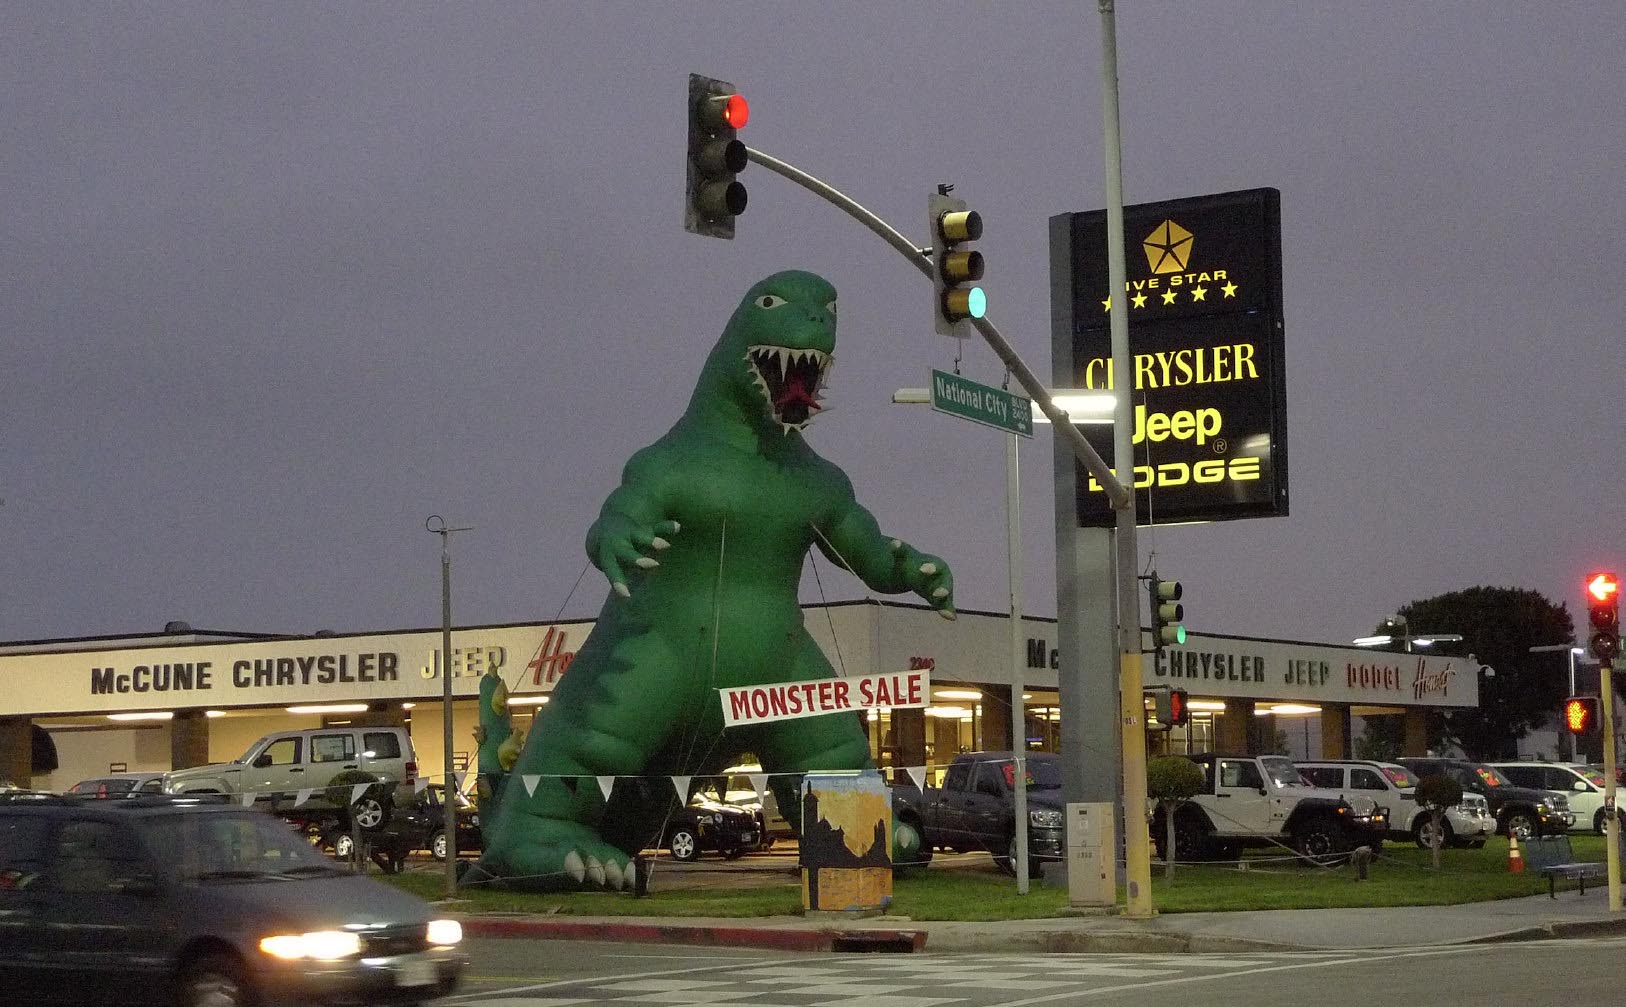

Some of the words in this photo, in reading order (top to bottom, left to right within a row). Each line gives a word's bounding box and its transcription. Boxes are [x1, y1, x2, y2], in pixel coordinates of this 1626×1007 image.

[1125, 277, 1160, 291] IVE
[1170, 269, 1228, 287] STAR
[936, 376, 982, 410] National
[985, 391, 1008, 423] City
[1131, 404, 1222, 446] Jeep
[91, 661, 213, 695] McCUNE
[232, 652, 399, 688] CHRYSLER
[1154, 649, 1265, 683] CHRYSLER
[1284, 658, 1330, 687] JEEP
[728, 680, 852, 721] MONSTER
[859, 673, 922, 707] SALE
